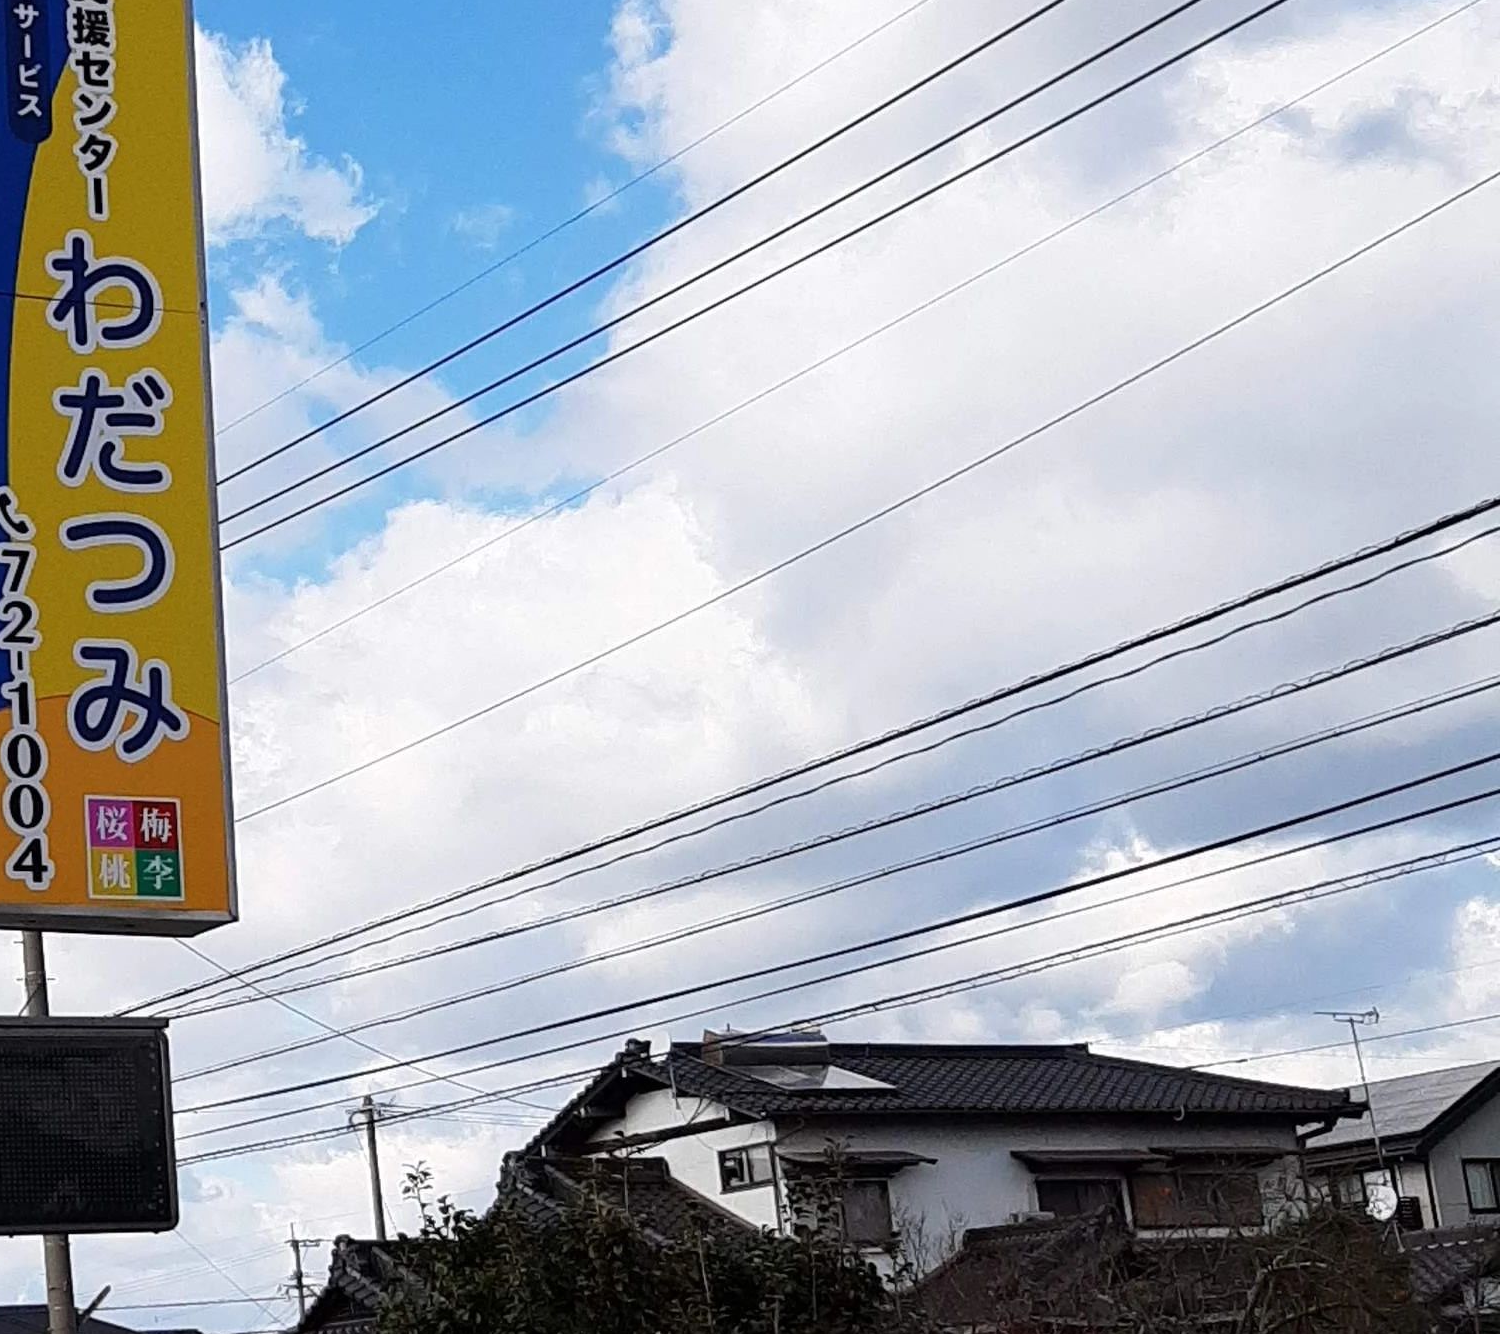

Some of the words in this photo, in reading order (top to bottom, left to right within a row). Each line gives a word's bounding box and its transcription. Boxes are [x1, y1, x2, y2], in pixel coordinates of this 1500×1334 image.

[51, 237, 183, 756] わだつみ
[0, 549, 49, 884] 72-1004
